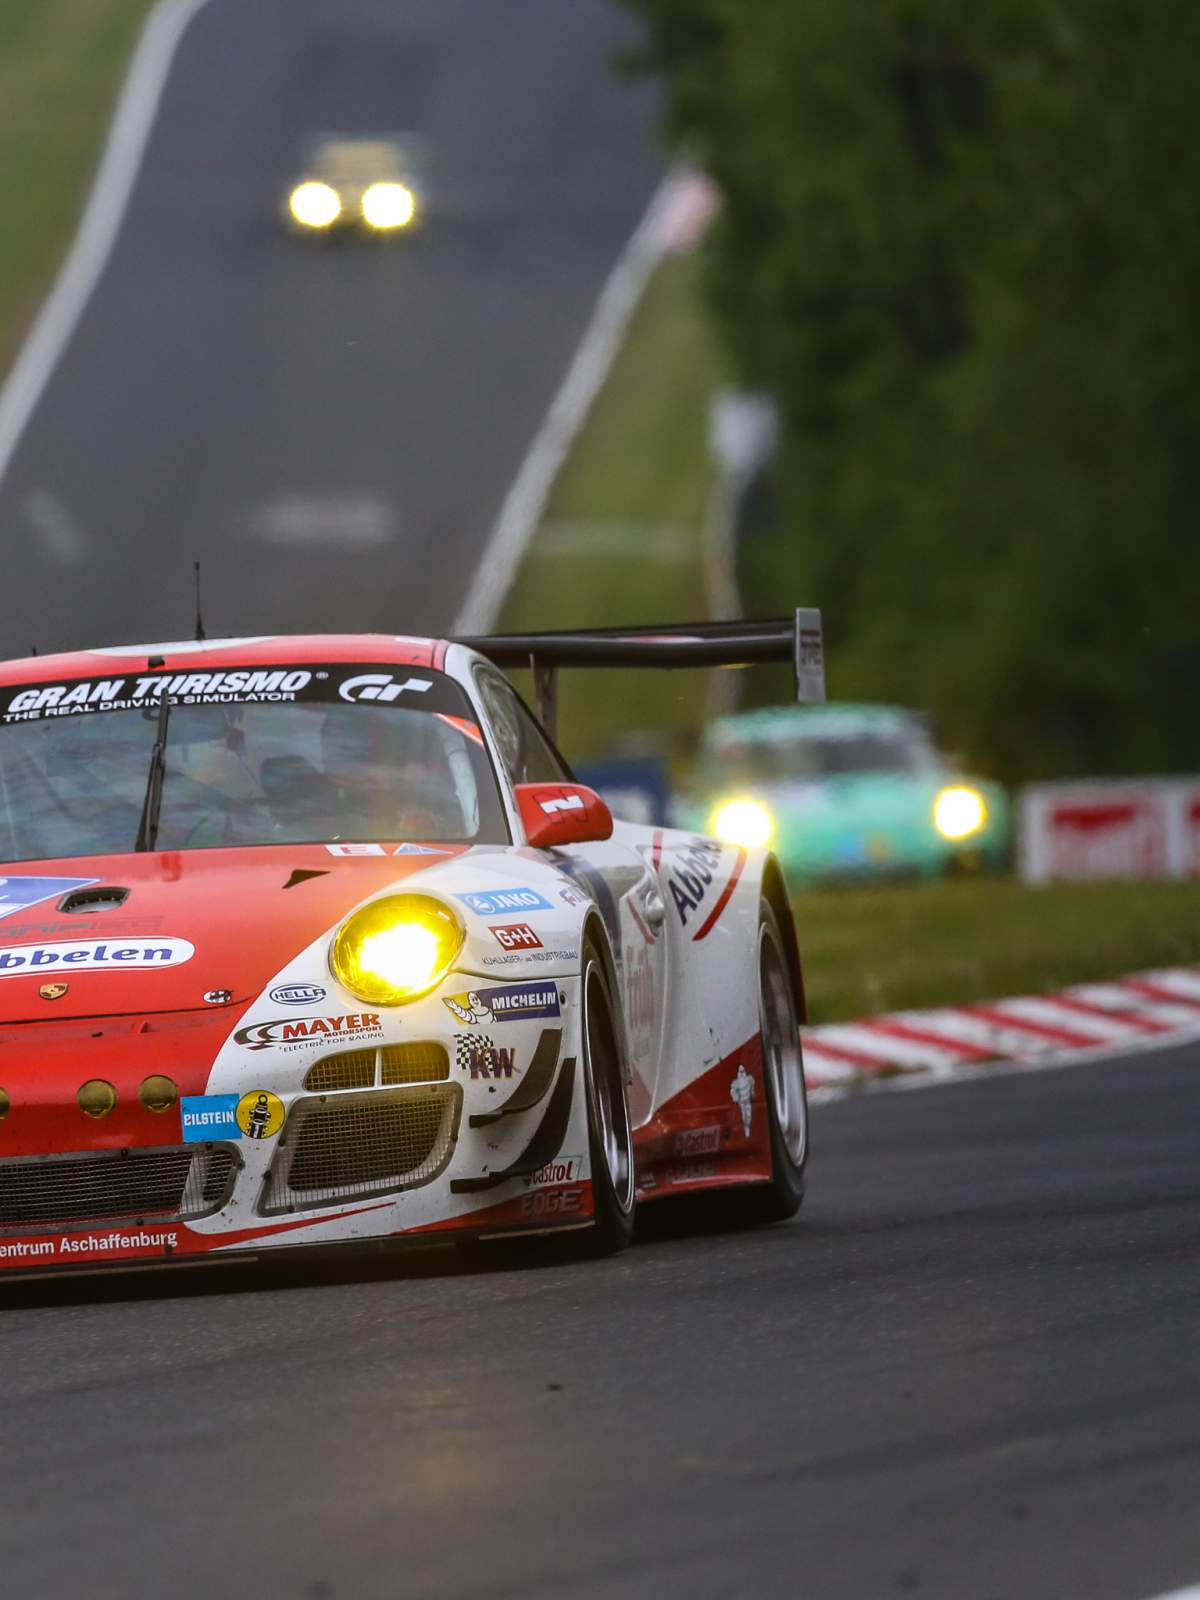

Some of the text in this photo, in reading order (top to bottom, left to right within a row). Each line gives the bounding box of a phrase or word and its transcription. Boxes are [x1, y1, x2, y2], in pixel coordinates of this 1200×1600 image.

[8, 671, 312, 712] GRAN TURISMO
[3, 709, 41, 722] THE
[45, 704, 95, 717] REAL
[183, 692, 296, 704] SIMULATOR
[490, 892, 540, 909] JAKO
[494, 927, 539, 947] G+H
[274, 988, 327, 1000] HELLA
[491, 991, 557, 1010] MICHELIN
[282, 1013, 381, 1039] MAYER
[323, 1026, 383, 1038] MOTORSPORT
[283, 1041, 324, 1053] ELECTRIC
[348, 1032, 385, 1042] RACING
[469, 1047, 516, 1079] KW
[183, 1110, 234, 1127] BILSTEIN
[60, 1231, 178, 1254] Aschaffenburg
